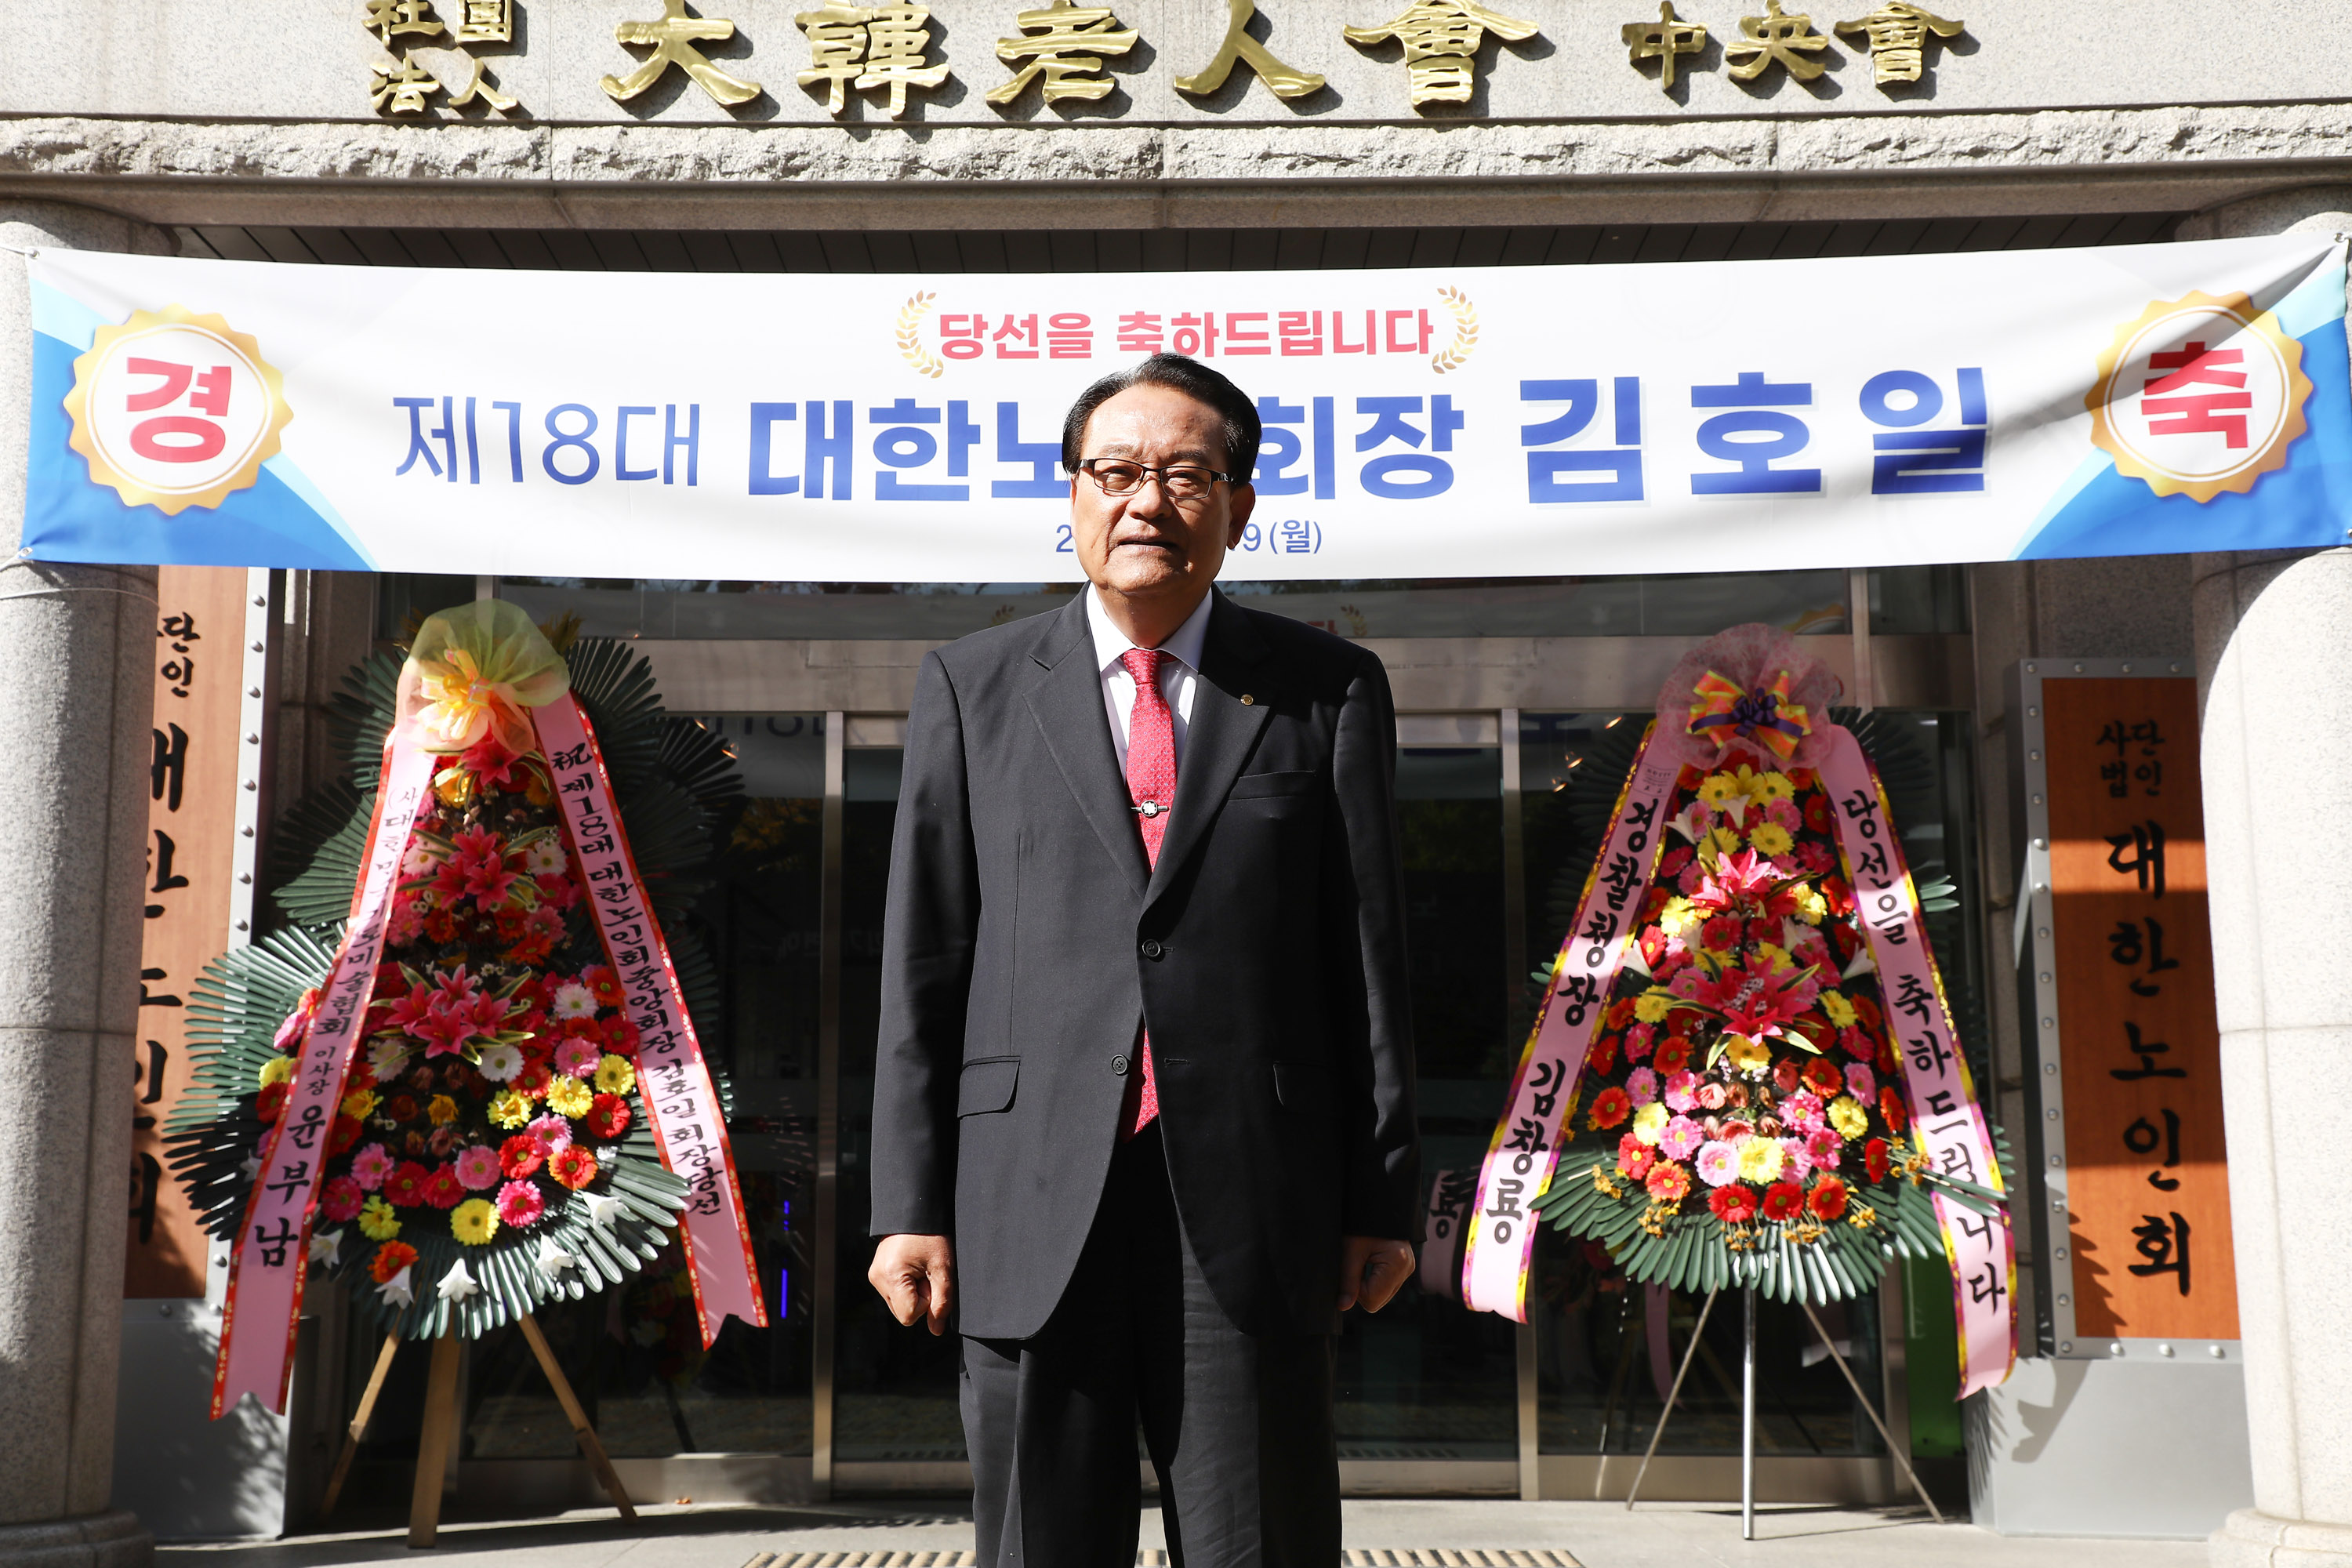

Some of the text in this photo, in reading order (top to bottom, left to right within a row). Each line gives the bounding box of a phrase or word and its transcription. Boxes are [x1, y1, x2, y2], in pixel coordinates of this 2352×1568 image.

[365, 0, 514, 49] 社團
[1621, 0, 1965, 92] 中央會
[369, 56, 520, 115] 法人
[939, 308, 1435, 361] 당선을 축하드립니다
[126, 357, 232, 463] 경
[2140, 341, 2252, 449] 축
[392, 366, 1988, 504] 제18대 대한노회장 김호일
[1232, 519, 1323, 554] 9(월)
[157, 611, 201, 653] 단
[550, 742, 593, 771] 祝
[2096, 718, 2166, 757] 사단
[559, 772, 616, 855] 제18대
[2100, 759, 2162, 798] 법인
[1486, 797, 1660, 1244] 경찰청장 김창룡
[1841, 789, 2006, 1316] 당선을 축하드립니다
[303, 1045, 336, 1097] 이사장
[2103, 819, 2191, 1298] 대한노인회
[254, 1104, 327, 1268] 윤부남
